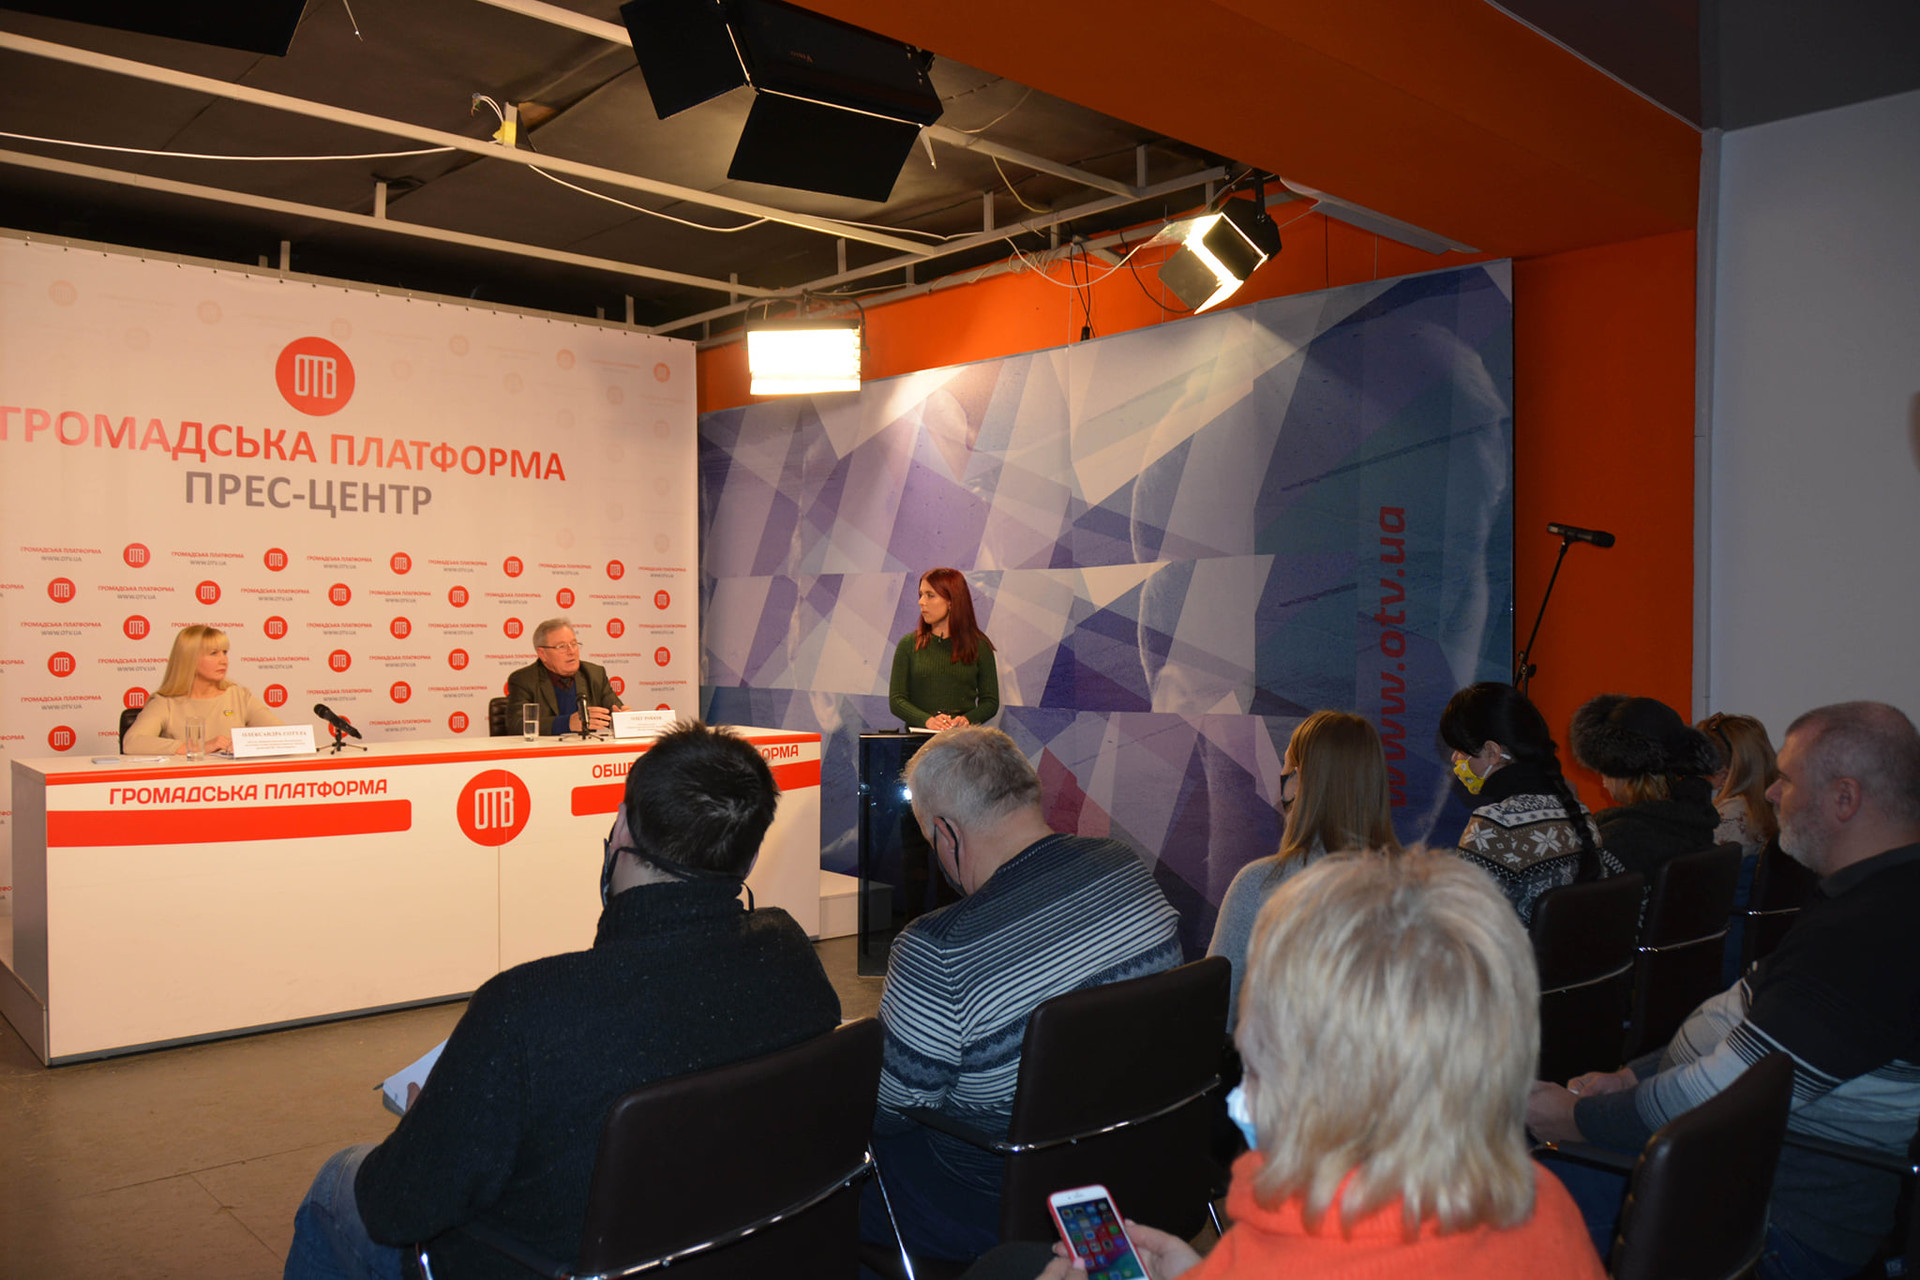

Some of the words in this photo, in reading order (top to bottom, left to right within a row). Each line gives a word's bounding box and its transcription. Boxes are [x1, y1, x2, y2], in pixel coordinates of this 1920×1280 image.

[295, 354, 337, 399] ОТВ
[0, 406, 317, 463] ГРОМАДСЬКА
[330, 433, 566, 482] ПЛАТФОРМА
[186, 471, 432, 519] ПРЕС-ЦЕНТР
[1374, 506, 1407, 807] www.otv.ua
[109, 785, 258, 805] ГРОМАДСЬКА
[264, 779, 388, 799] ПЛАТФОРМА
[474, 786, 514, 830] ОТВ
